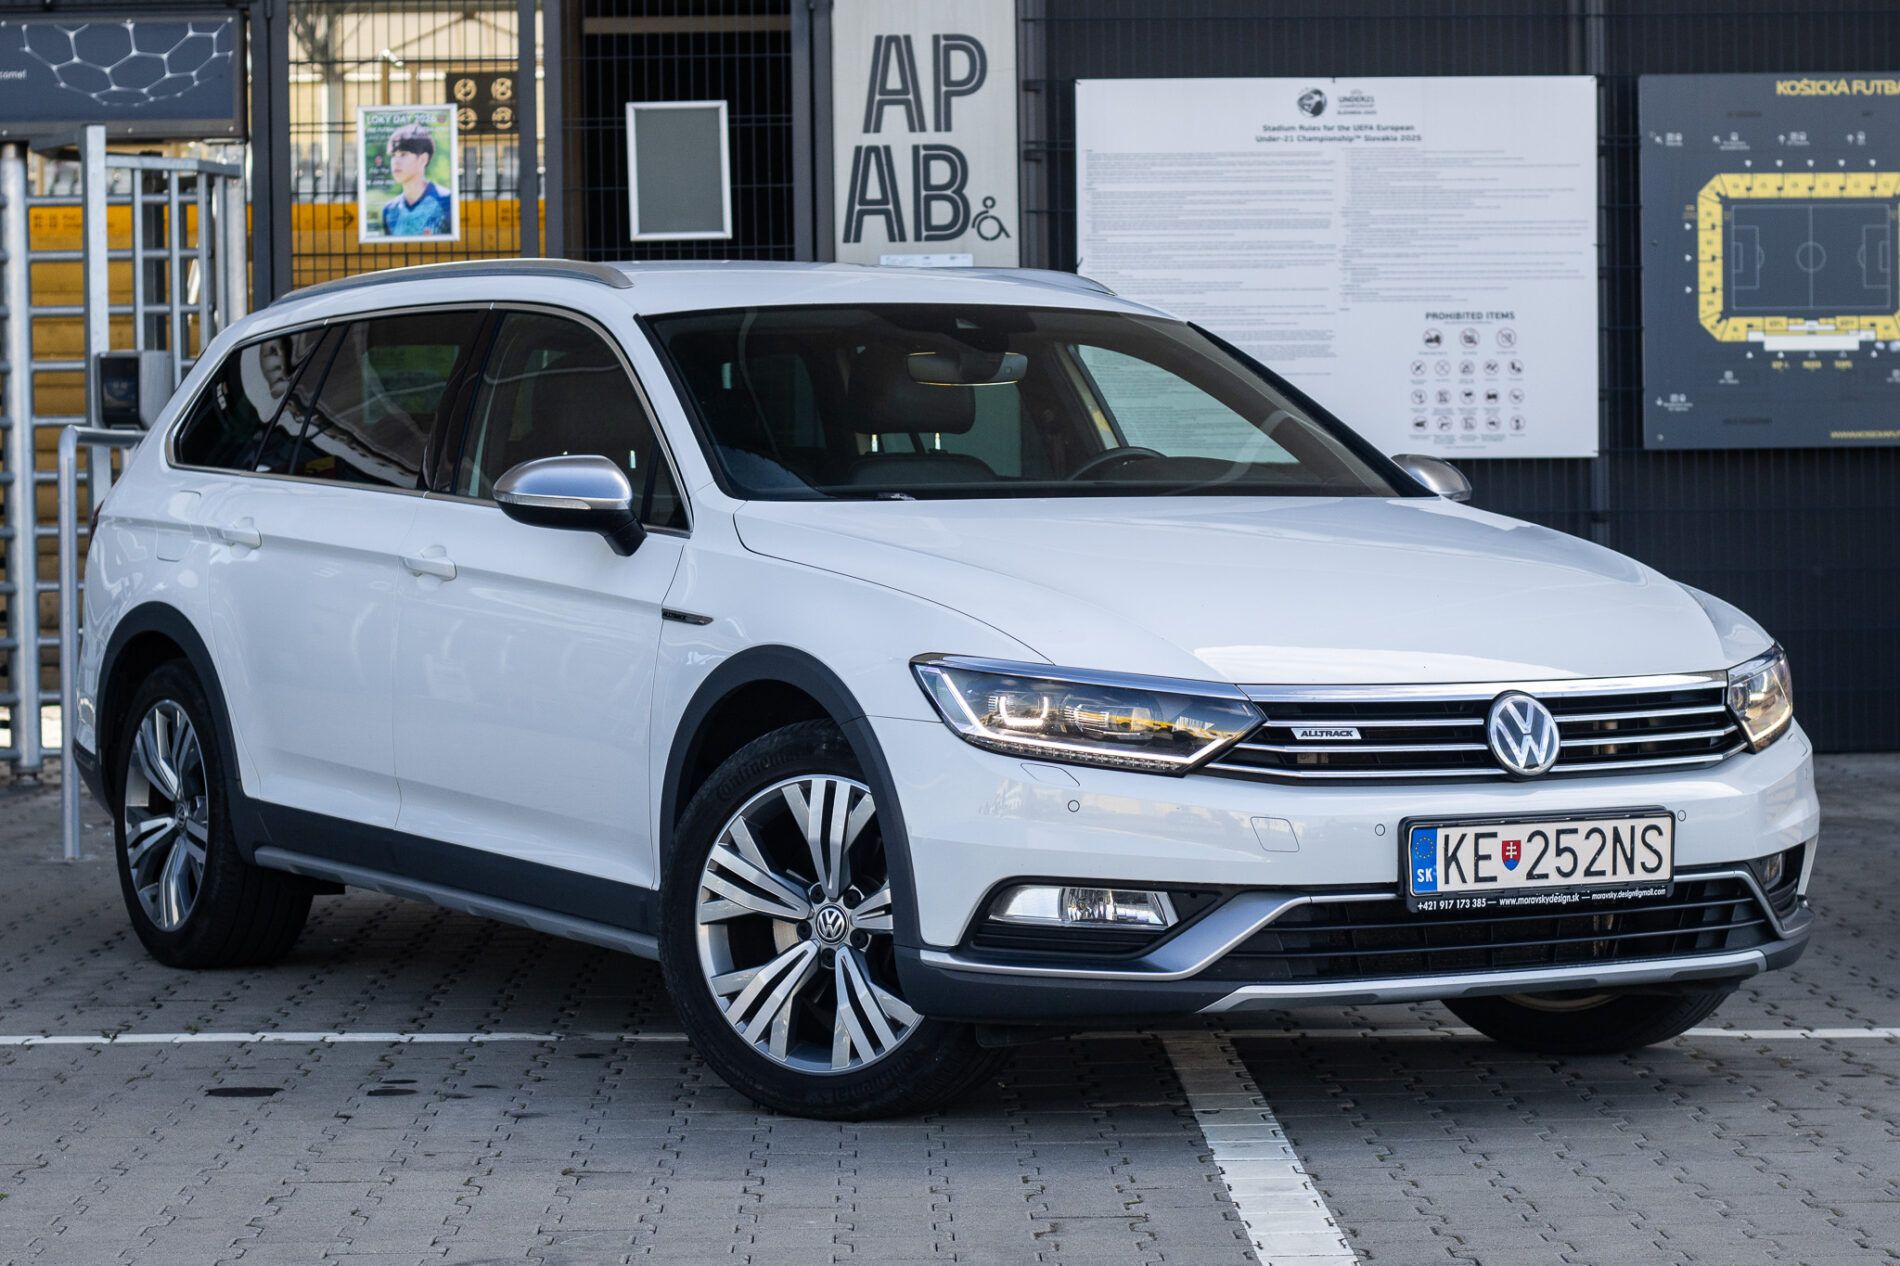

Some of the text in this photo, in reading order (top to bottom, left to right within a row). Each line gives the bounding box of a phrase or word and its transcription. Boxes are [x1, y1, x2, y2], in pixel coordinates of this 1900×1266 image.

[862, 34, 988, 133] AP
[1775, 77, 1850, 96] KOŠICKÁ
[1262, 124, 1415, 134] Stadium Rules for the UEFA European
[1364, 134, 1398, 142] Slovakia
[1400, 134, 1422, 142] 2025
[843, 144, 972, 243] AB
[1425, 311, 1515, 320] PROHIBITED ITEMS
[1300, 729, 1354, 738] ALLTRACK
[1442, 823, 1664, 885] KE 252NS
[1416, 867, 1433, 883] SK
[1417, 900, 1437, 911] +421
[1439, 899, 1454, 910] 917
[1456, 898, 1470, 909] 173
[1472, 898, 1487, 908] 385
[1499, 892, 1579, 905] www.moravskydesign.sk
